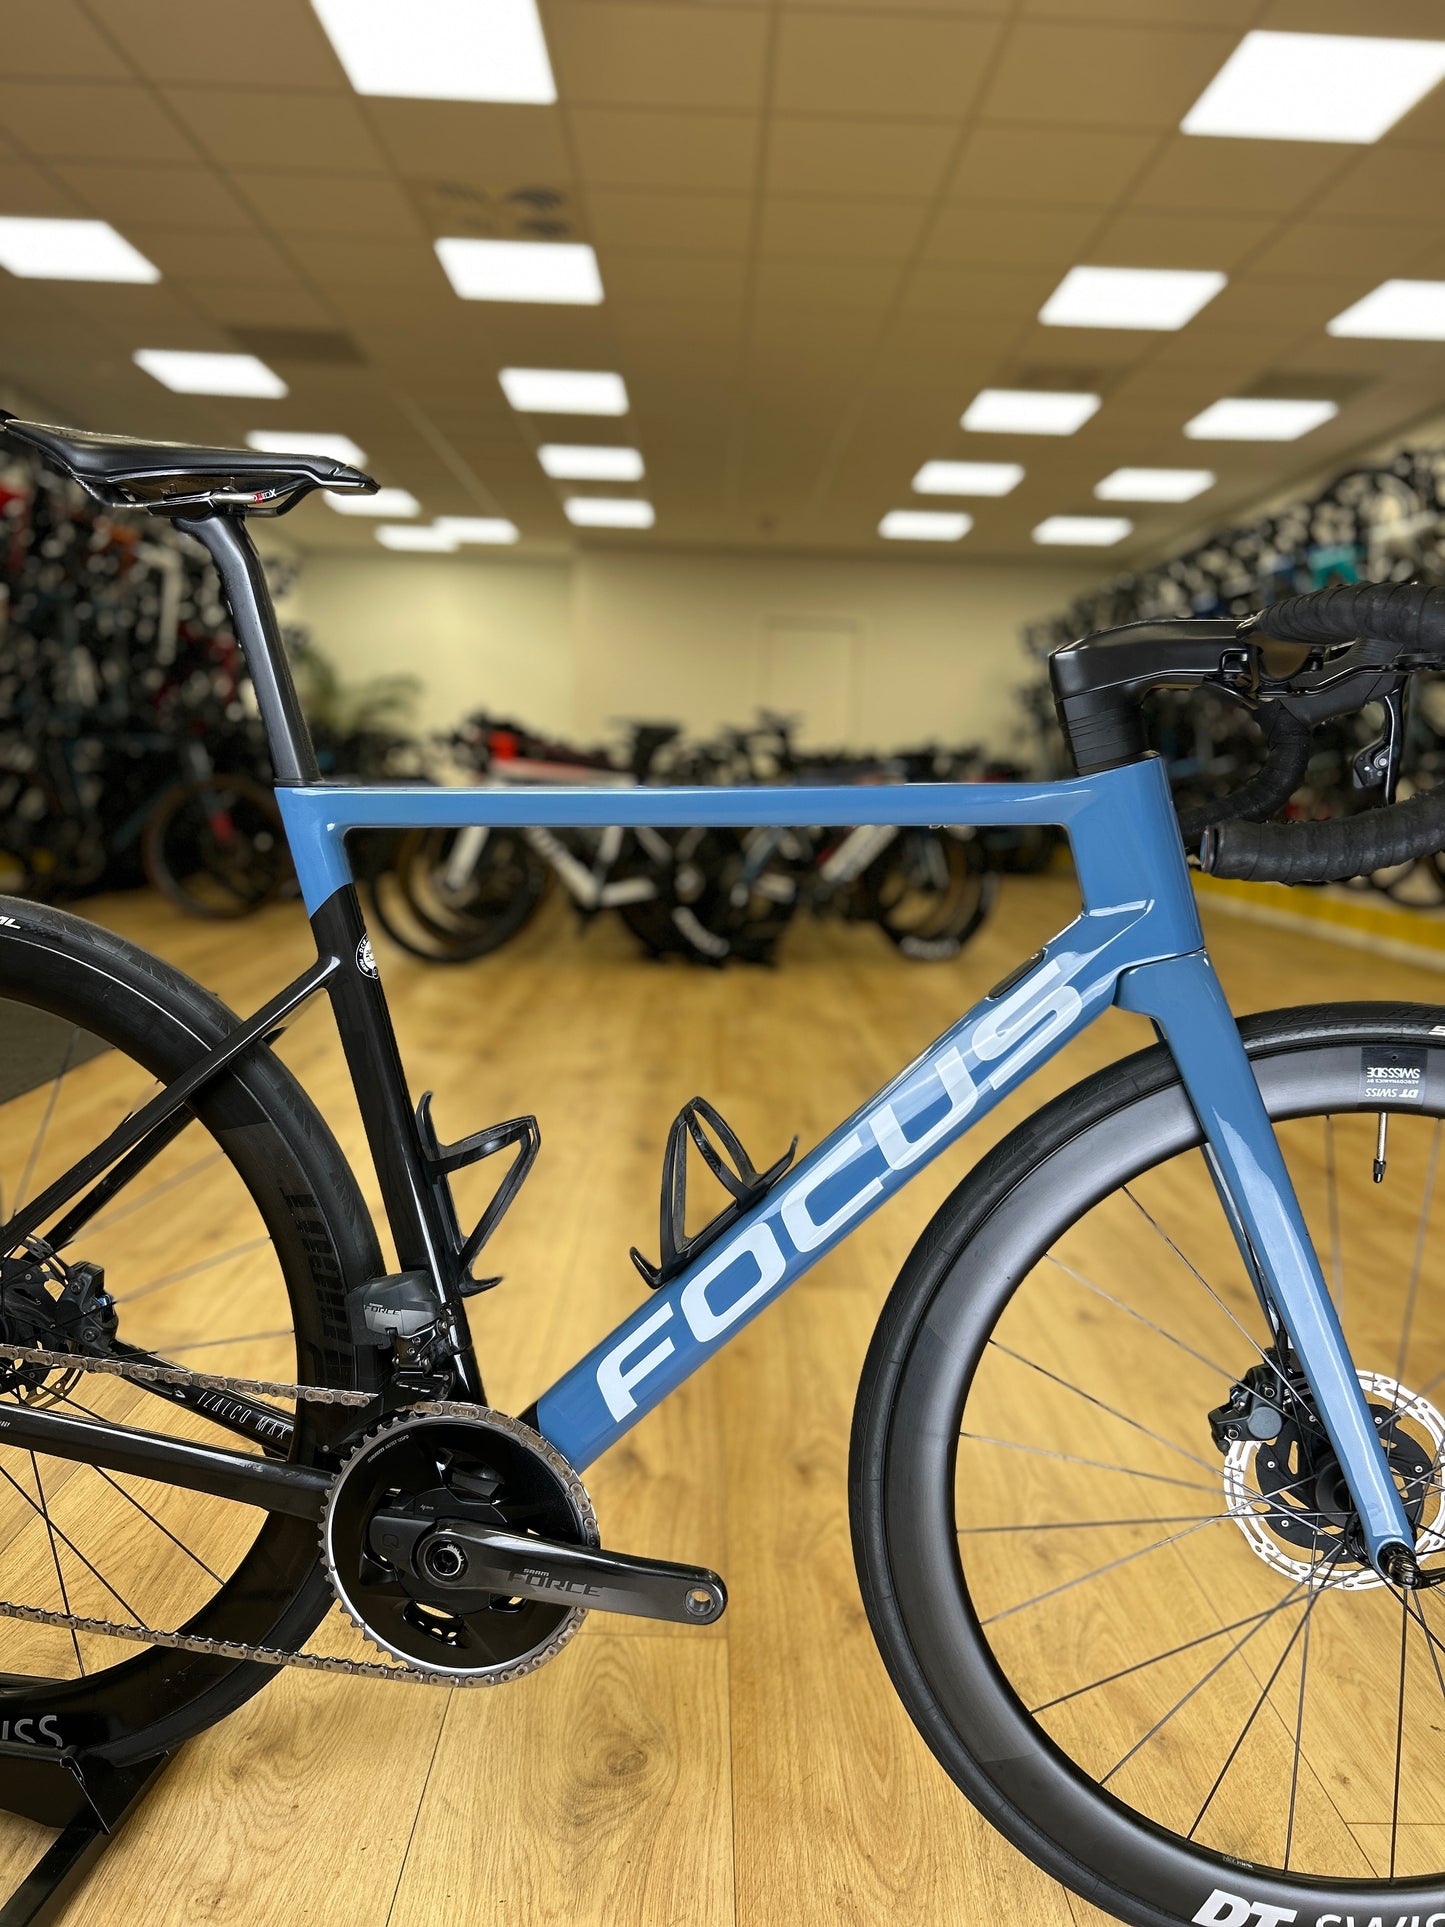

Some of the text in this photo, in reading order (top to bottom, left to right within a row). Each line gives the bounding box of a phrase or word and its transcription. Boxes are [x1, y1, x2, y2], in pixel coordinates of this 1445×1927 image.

[1364, 1087, 1420, 1099] DT SWISS
[596, 960, 1083, 1422] FOCUS
[196, 1391, 289, 1440] IZALCO MAX
[506, 1570, 601, 1598] FORCE
[1191, 1888, 1298, 1927] DT
